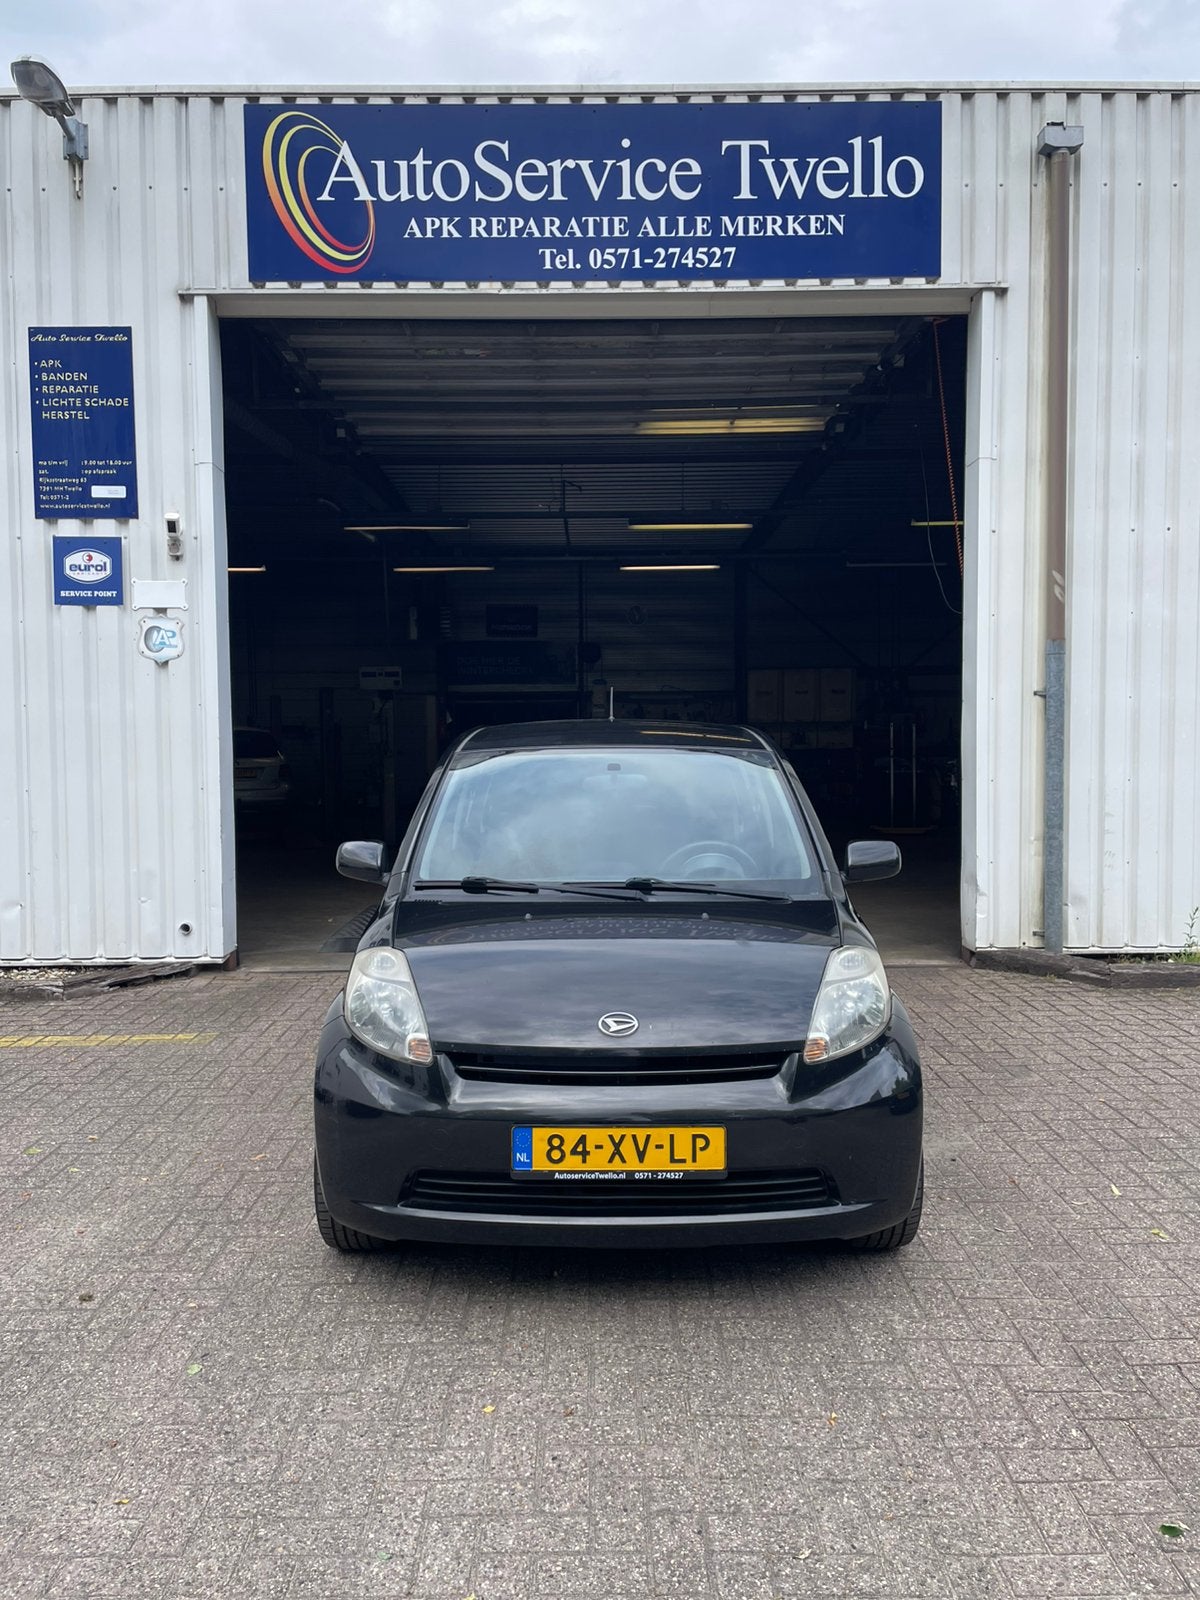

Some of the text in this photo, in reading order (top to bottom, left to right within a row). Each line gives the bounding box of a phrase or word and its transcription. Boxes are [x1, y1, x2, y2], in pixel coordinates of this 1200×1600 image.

[316, 135, 925, 202] AutoService Twello
[403, 214, 846, 238] APK REPARATIE ALLE MERKEN
[539, 247, 736, 269] Tel. 0571-274527
[31, 333, 128, 342] Auto Service Twello
[40, 360, 62, 368] APK
[41, 372, 88, 381] BANDEN
[42, 385, 99, 394] REPARATIE
[42, 397, 129, 407] LICHTE SCHADE
[42, 411, 90, 420] HERSTEL
[69, 561, 107, 572] eurol
[516, 1133, 711, 1165] NL 84-XV-LP
[554, 1171, 626, 1180] AutoserviceTwello.nl
